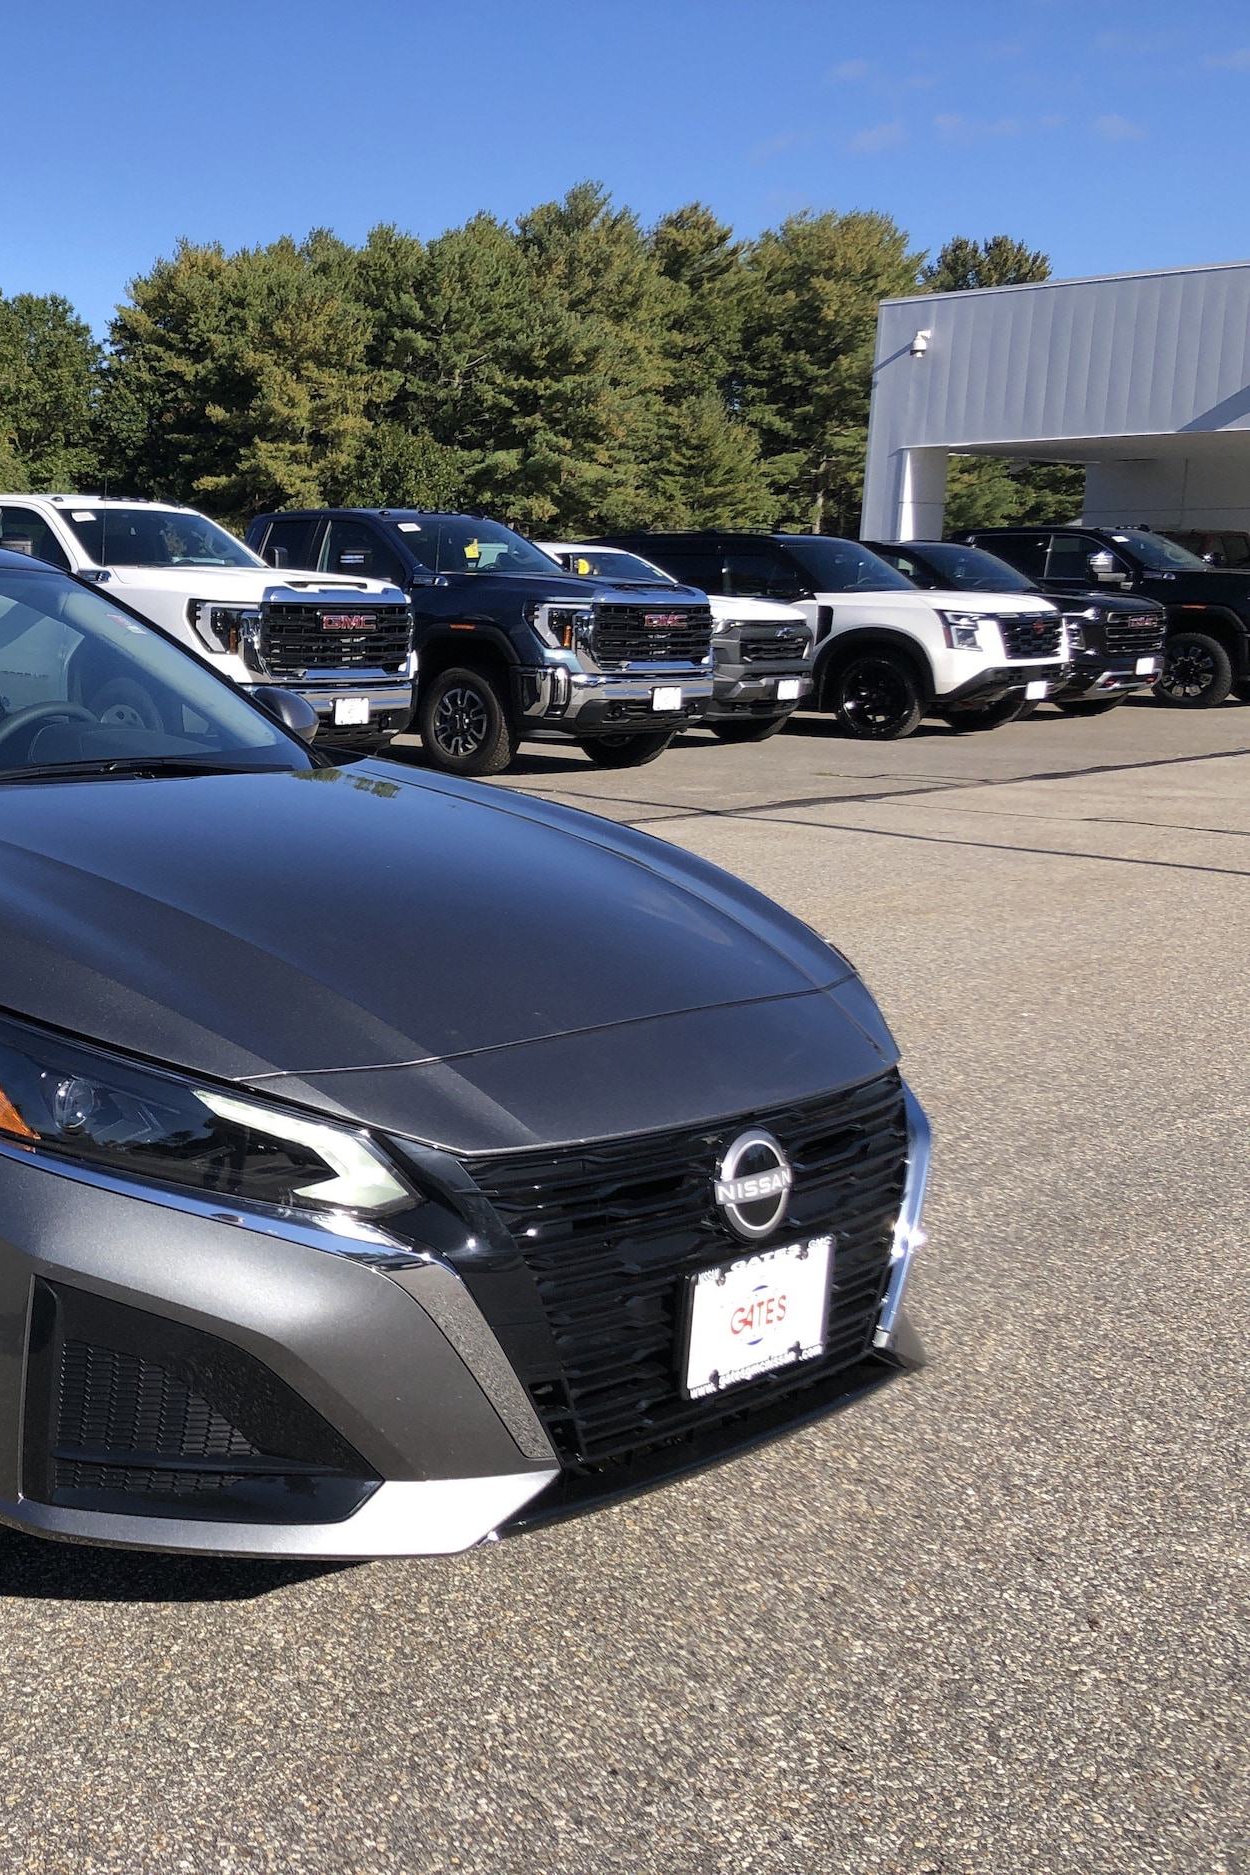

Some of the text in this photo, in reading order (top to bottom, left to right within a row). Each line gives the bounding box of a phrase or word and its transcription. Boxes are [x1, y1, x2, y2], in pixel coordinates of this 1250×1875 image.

[323, 614, 377, 630] GMC
[644, 613, 688, 628] GMC
[717, 1167, 792, 1202] NISSAN
[730, 1294, 787, 1335] GATES
